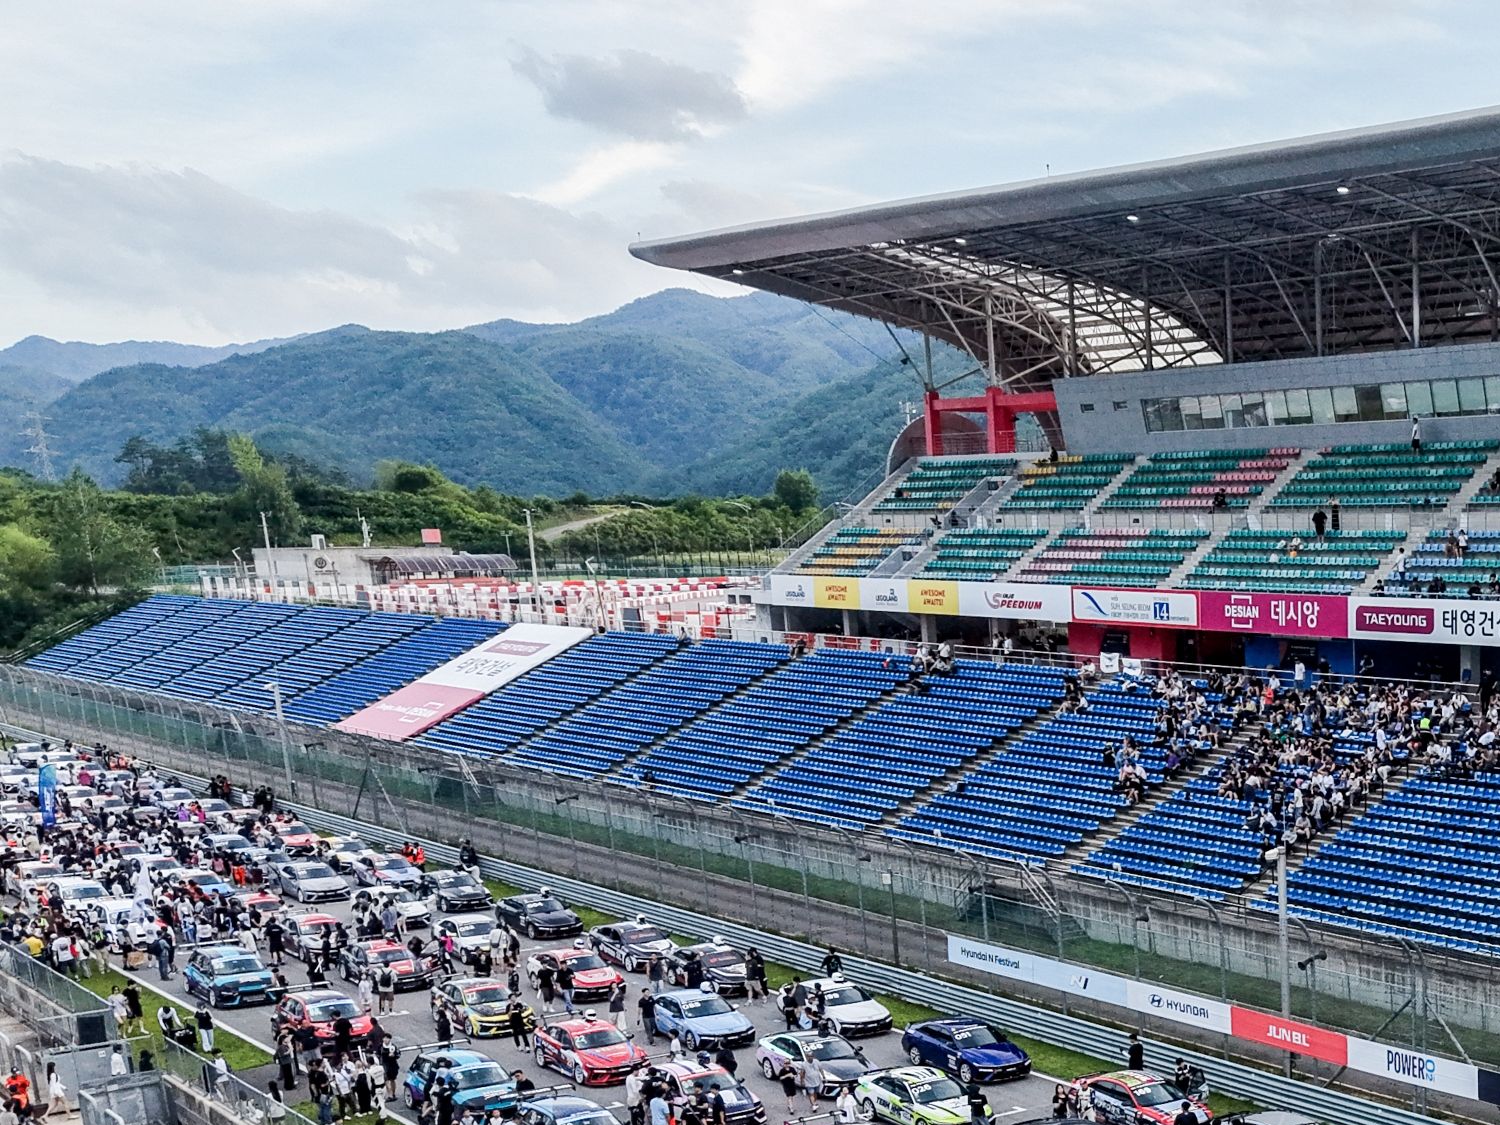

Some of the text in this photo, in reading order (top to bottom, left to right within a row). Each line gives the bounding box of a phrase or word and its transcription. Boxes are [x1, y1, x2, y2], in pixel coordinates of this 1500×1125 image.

[1224, 604, 1259, 619] DESIAN
[1270, 600, 1320, 628] 데시앙
[1363, 612, 1427, 628] TAEYOUNG
[960, 946, 987, 963] Hyundai
[995, 955, 1020, 969] Festival
[1166, 998, 1209, 1019] HYUNDAI
